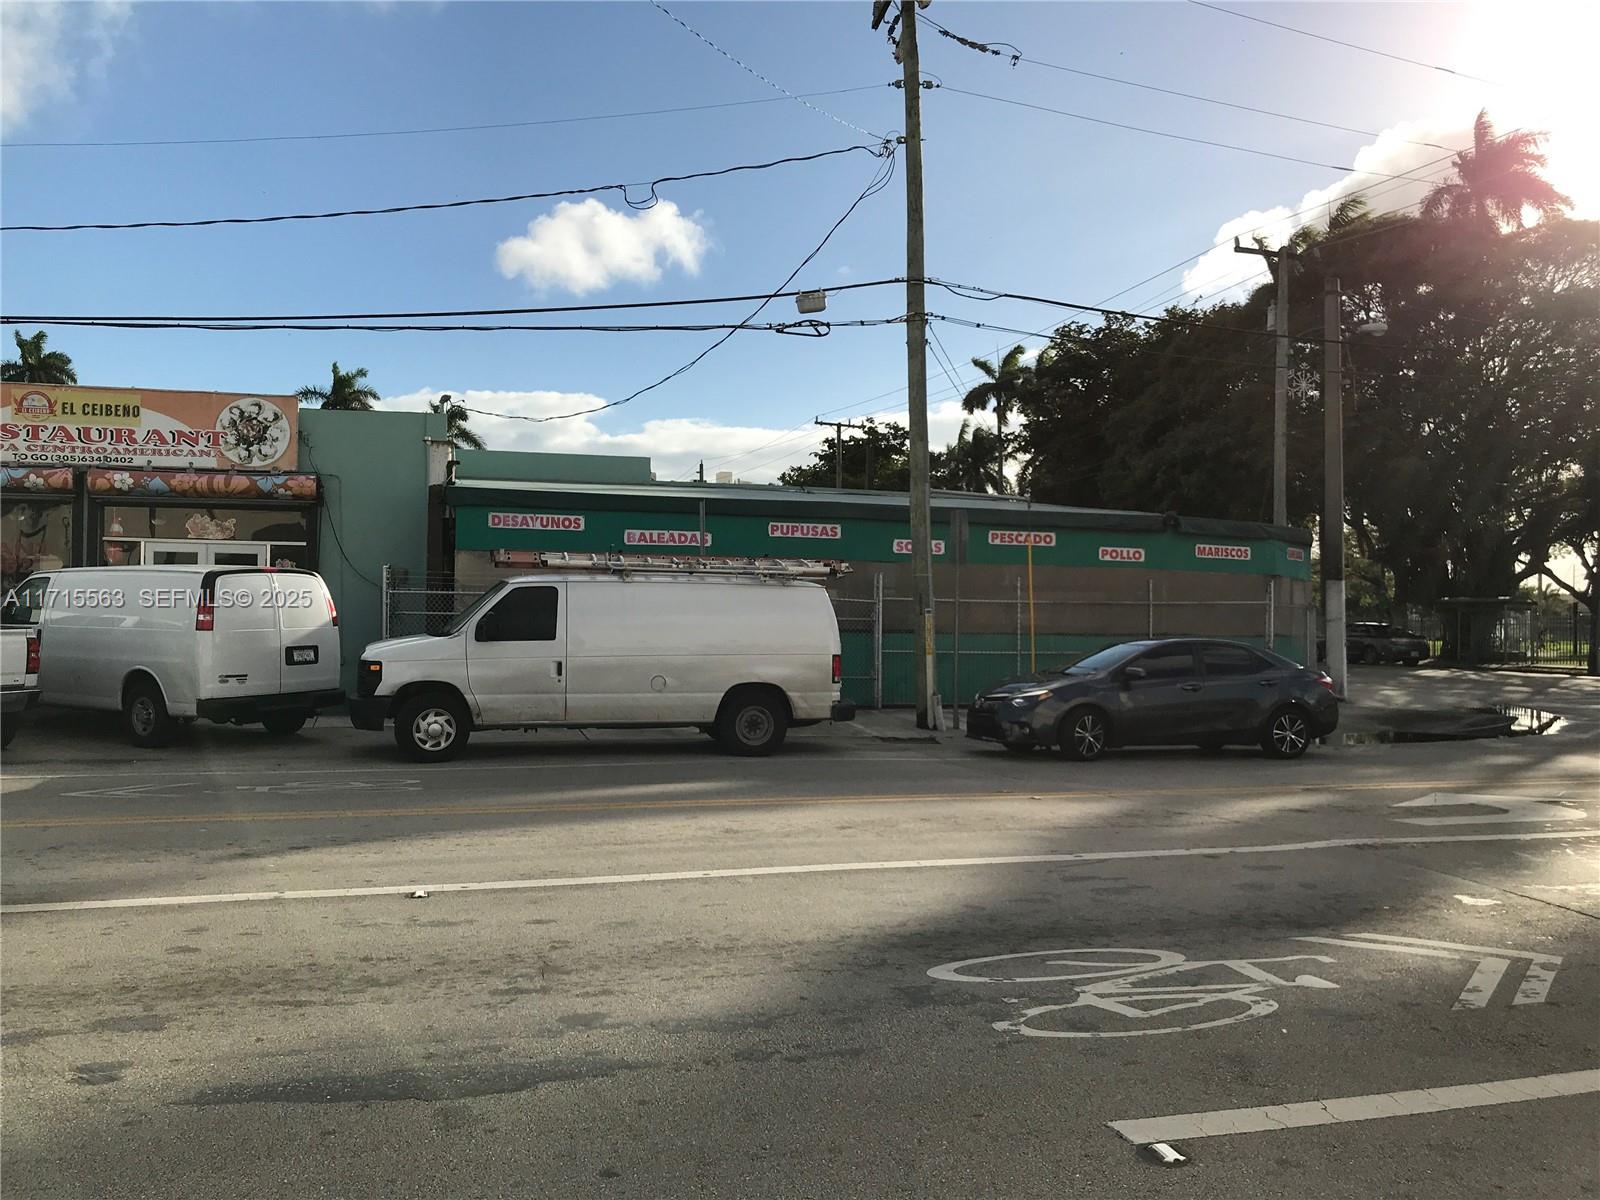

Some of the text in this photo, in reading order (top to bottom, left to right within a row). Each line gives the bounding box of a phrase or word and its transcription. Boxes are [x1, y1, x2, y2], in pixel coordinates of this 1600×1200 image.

[61, 401, 77, 416] EL
[491, 514, 581, 529] DESAYUNOS
[770, 524, 838, 537] PUPUSAS
[991, 531, 1052, 545] PESCADO
[895, 541, 942, 553] SOS
[1197, 546, 1249, 559] MARISCOS
[1101, 549, 1142, 560] POLLO
